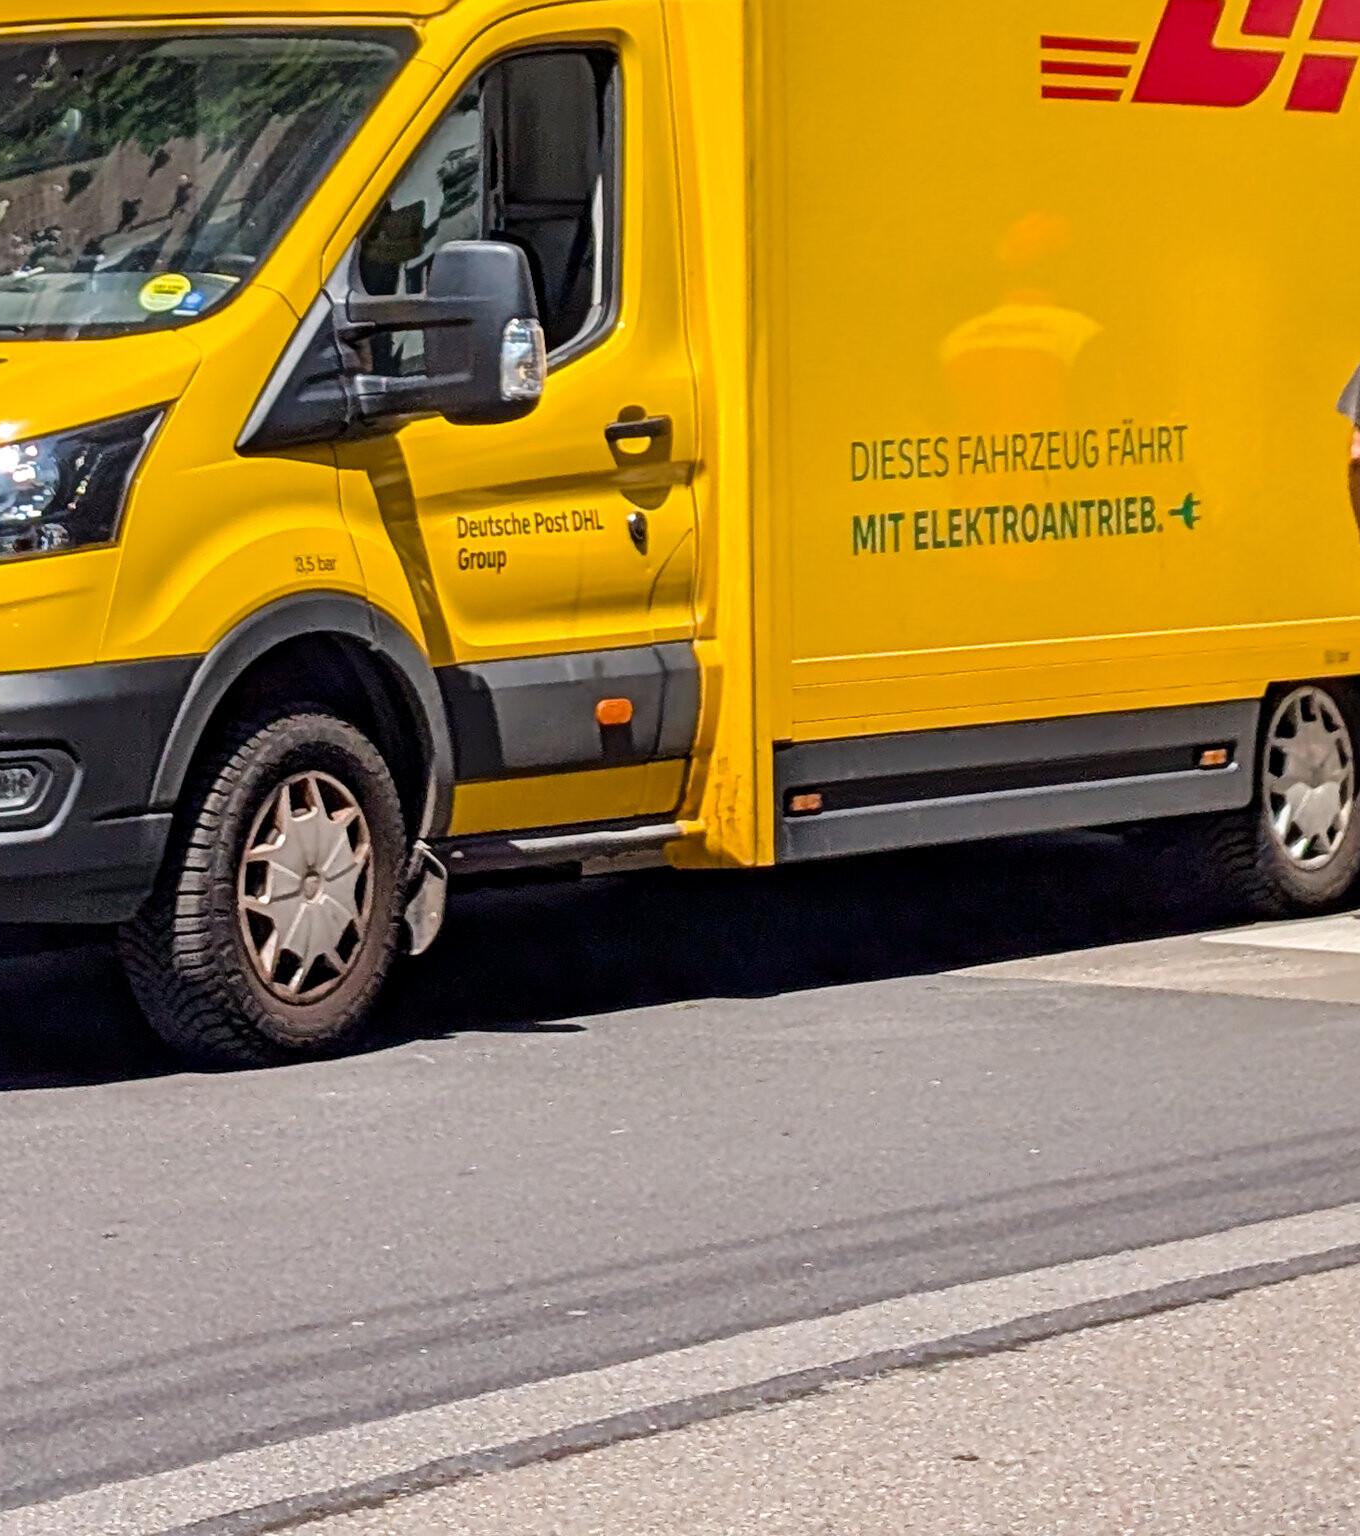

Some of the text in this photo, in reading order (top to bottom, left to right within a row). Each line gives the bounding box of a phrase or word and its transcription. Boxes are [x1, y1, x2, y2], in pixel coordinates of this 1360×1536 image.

[850, 418, 1189, 482] DIESES FAHRZEUG FÄHRT
[456, 509, 605, 540] Deutsche Post DHL
[852, 495, 1164, 556] MIT ELEKTROANTRIEB.
[457, 546, 508, 574] Group
